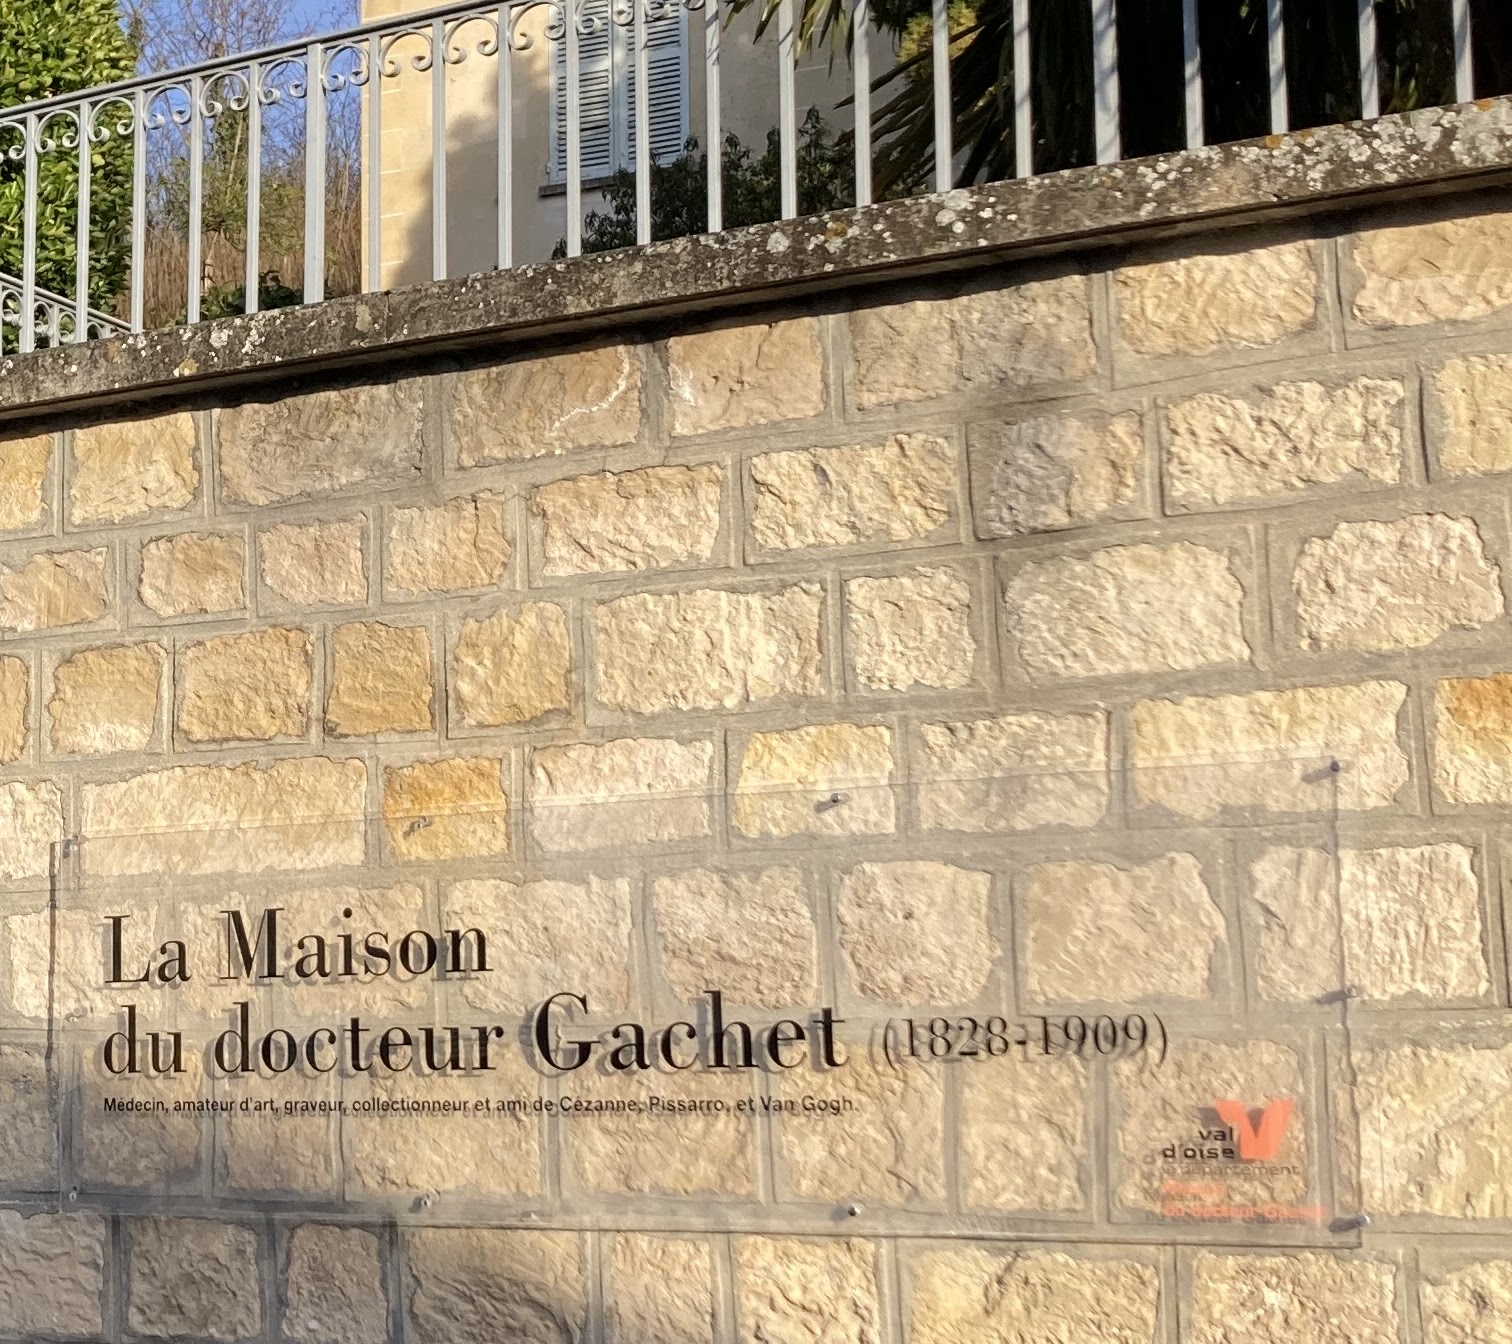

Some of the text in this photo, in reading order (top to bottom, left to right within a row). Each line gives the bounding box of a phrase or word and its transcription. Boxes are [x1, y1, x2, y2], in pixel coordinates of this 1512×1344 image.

[103, 907, 494, 984] La Maison
[103, 990, 1167, 1075] du docteur Gachet (1828-1909)
[103, 1094, 859, 1115] Médecin, amateur d'art, graveur, collectionneur et ami de Cézanne, Pissarro, et Van Gogh.
[1199, 1126, 1234, 1142] val
